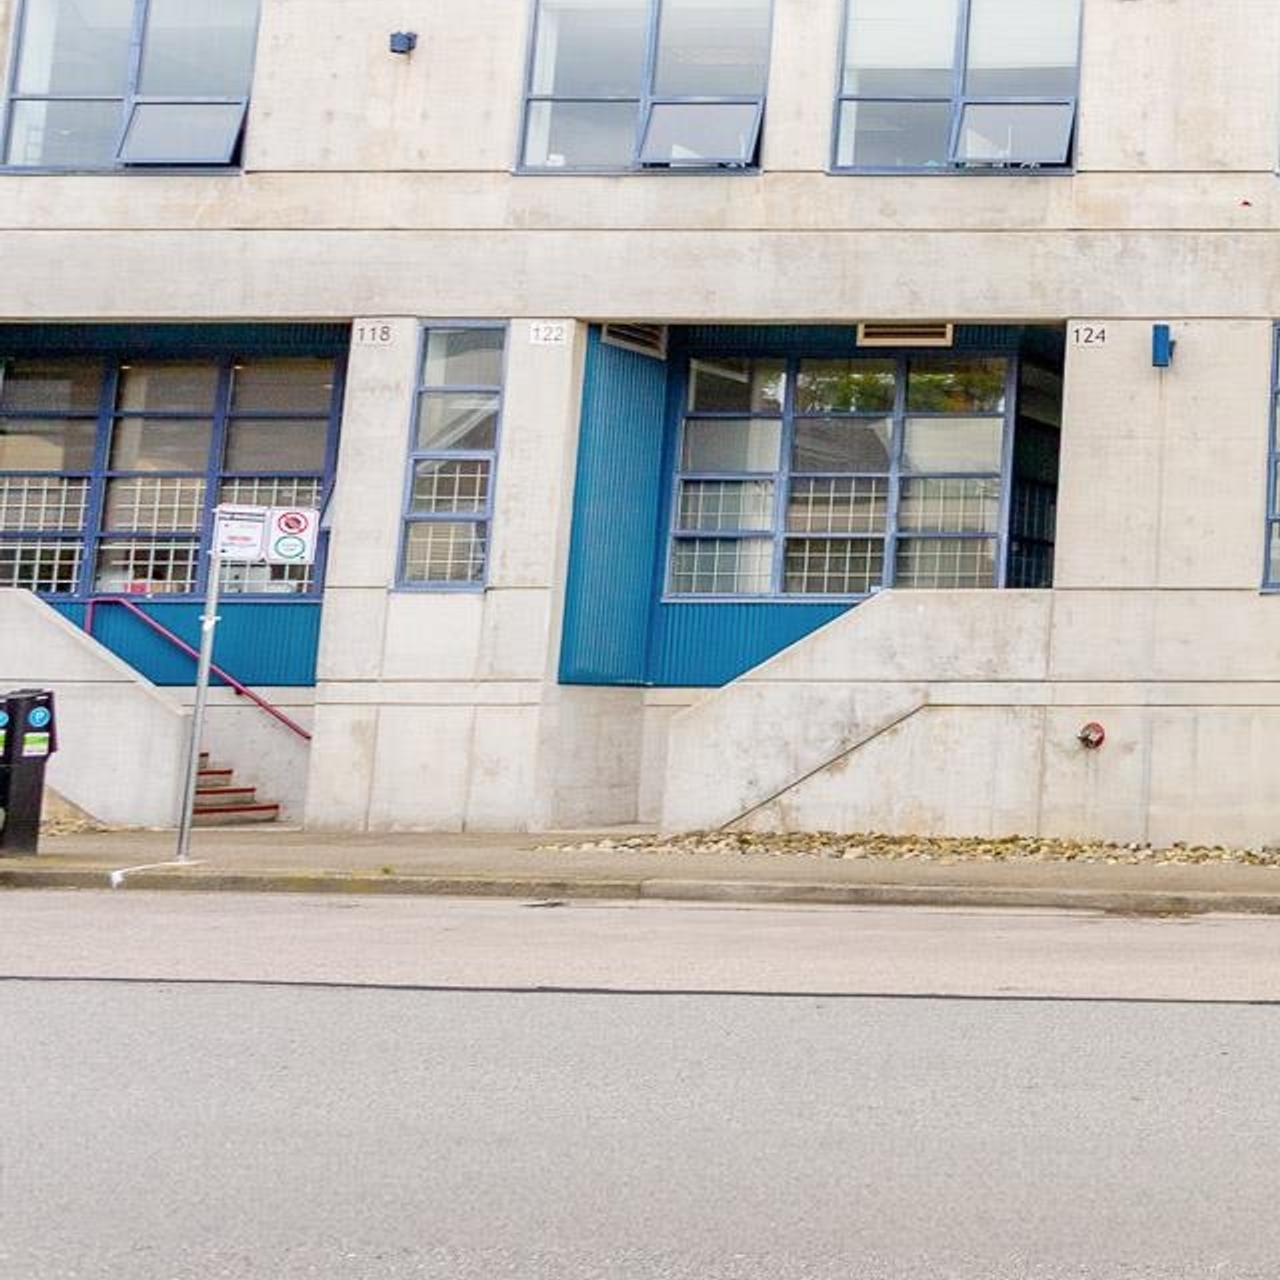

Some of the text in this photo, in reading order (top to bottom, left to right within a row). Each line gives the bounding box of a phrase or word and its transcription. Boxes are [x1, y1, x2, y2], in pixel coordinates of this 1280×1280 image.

[357, 326, 391, 341] 118
[533, 326, 564, 341] 122
[1073, 327, 1106, 344] 124
